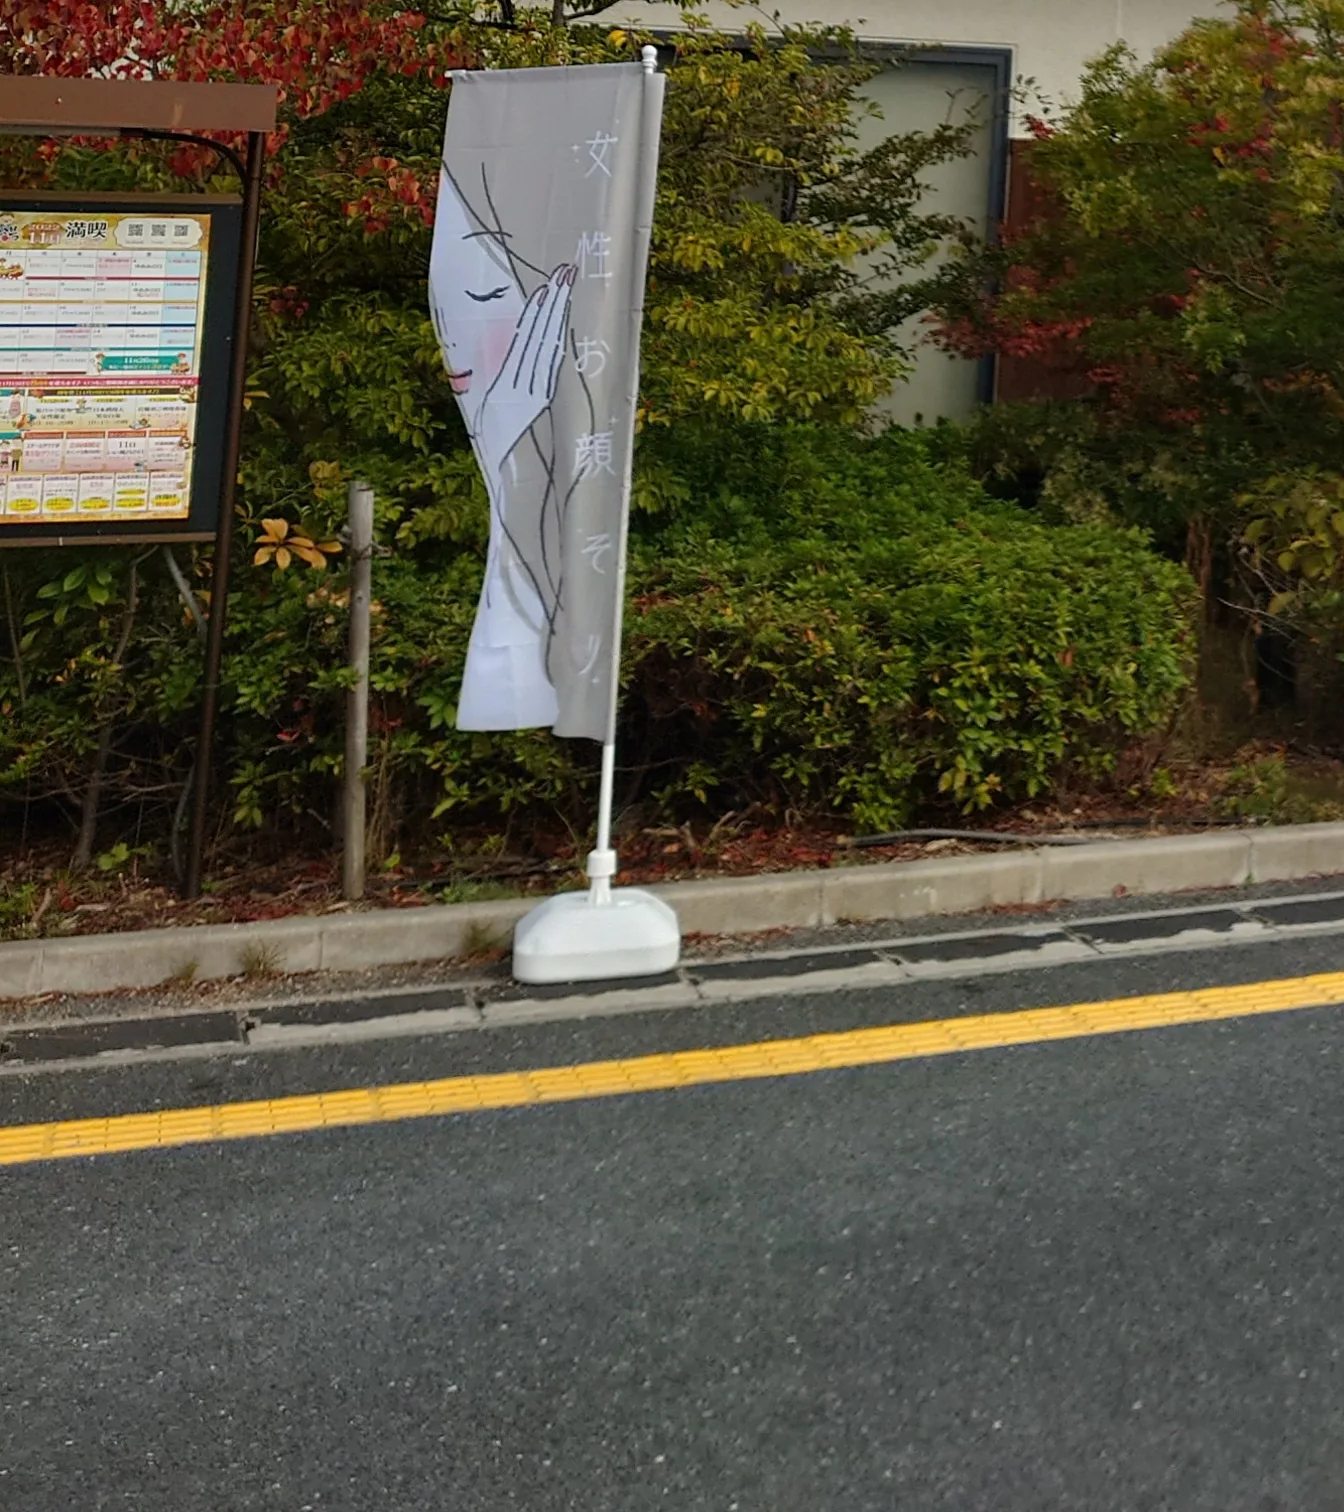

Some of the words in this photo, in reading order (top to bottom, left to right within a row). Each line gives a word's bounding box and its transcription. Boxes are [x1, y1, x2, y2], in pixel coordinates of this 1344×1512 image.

[66, 221, 108, 238] 満喫
[572, 130, 619, 676] 女性お顔そり
